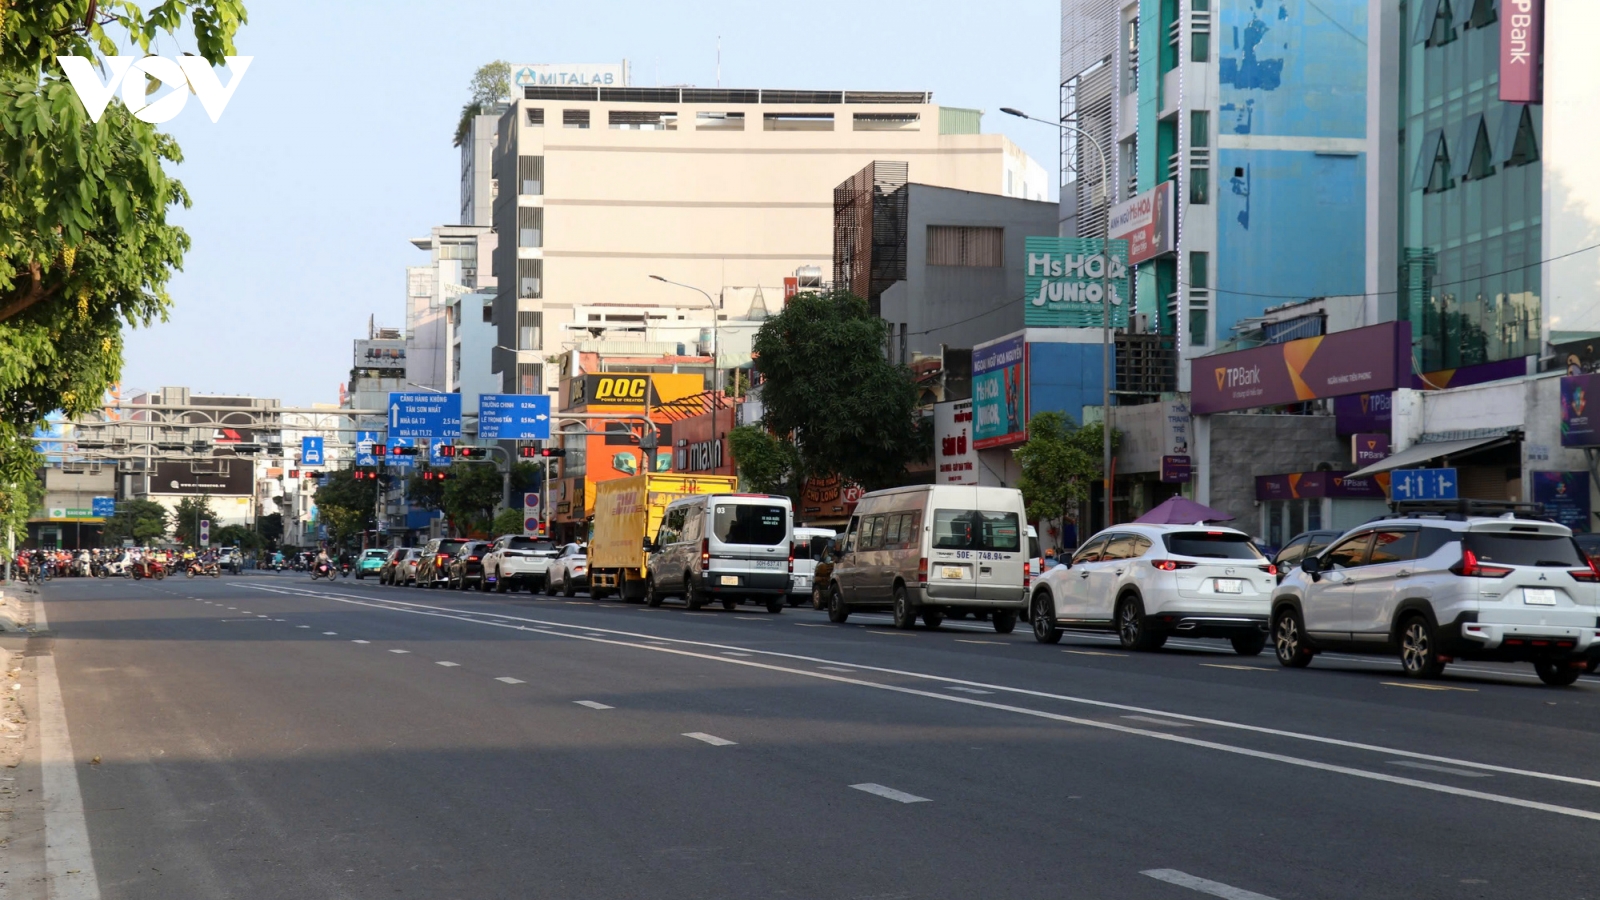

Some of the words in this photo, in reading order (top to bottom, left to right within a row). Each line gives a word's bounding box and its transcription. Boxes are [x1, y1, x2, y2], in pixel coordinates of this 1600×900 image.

[540, 73, 614, 85] MITALAB
[1065, 253, 1127, 279] HOA
[996, 352, 1006, 365] HOA
[1227, 364, 1260, 388] TPBank
[406, 404, 416, 412] TÂN
[400, 416, 410, 424] NHÀ
[400, 428, 410, 436] NHÀ
[821, 487, 838, 502] LONG
